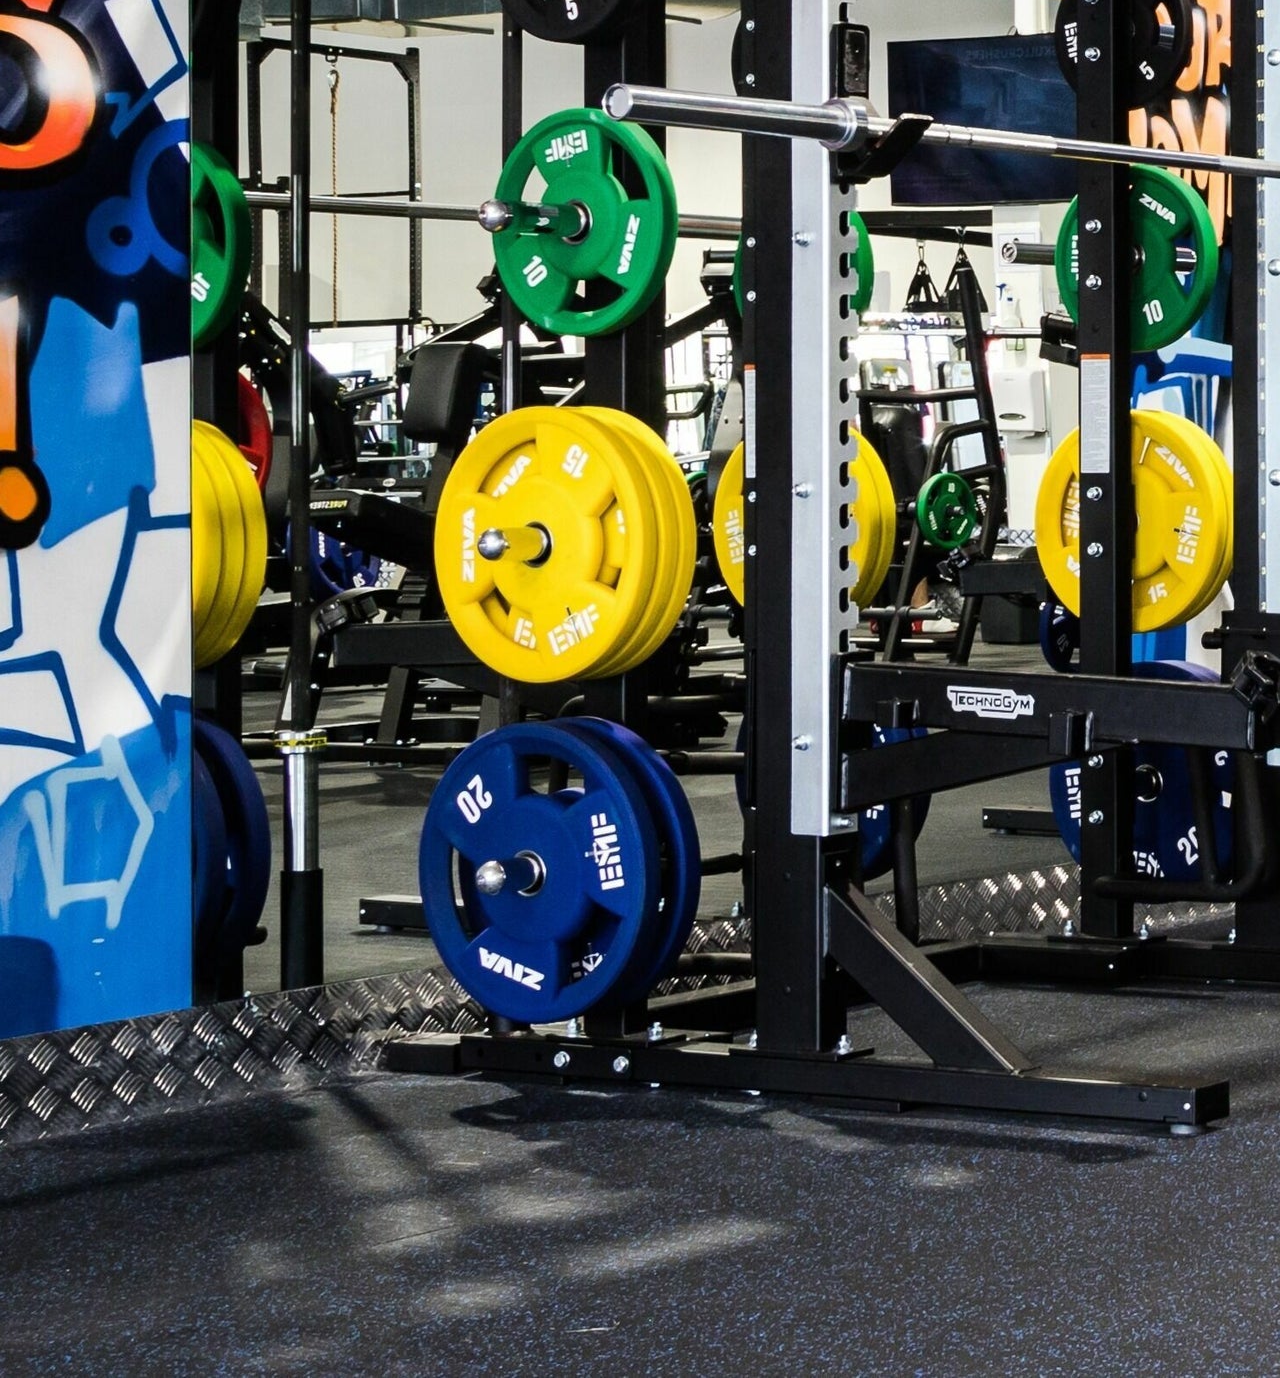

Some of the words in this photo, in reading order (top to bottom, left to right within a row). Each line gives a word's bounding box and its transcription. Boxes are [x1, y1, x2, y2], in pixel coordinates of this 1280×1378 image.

[1138, 61, 1155, 81] 5
[1138, 193, 1177, 226] ZIVA
[616, 213, 641, 275] ZIVA
[522, 254, 548, 288] 10
[1141, 299, 1164, 324] 10
[560, 443, 590, 479] 15
[462, 507, 476, 584] ZIVA
[1175, 505, 1203, 565] EMF
[546, 603, 600, 657] EMF
[950, 687, 1033, 714] TECHNOGYM
[456, 774, 493, 824] 20
[589, 812, 625, 891] EMF
[477, 946, 546, 992] ZIVA
